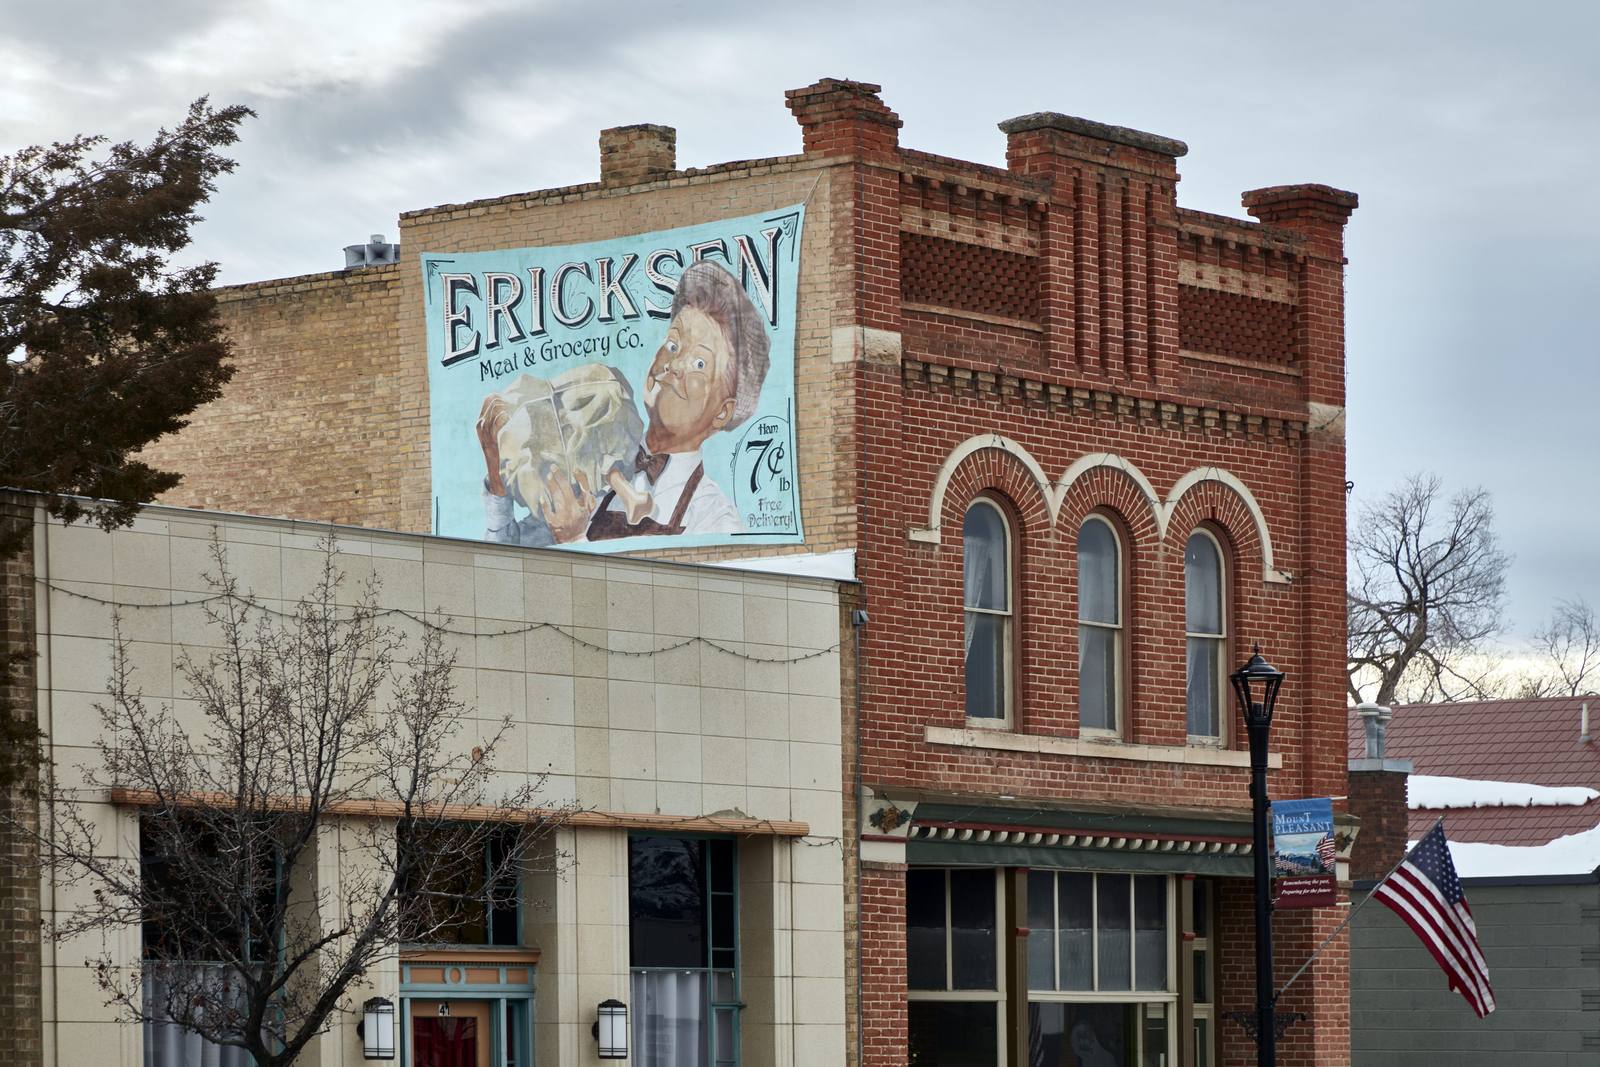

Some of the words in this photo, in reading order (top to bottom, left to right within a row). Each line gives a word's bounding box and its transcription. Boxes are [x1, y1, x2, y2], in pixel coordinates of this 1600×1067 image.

[440, 226, 784, 367] ERICKSN
[480, 353, 519, 381] Meat
[524, 346, 536, 367] &
[540, 339, 611, 361] Grocery
[616, 326, 644, 349] Co.
[758, 423, 779, 435] Ham
[779, 477, 791, 491] lb
[758, 498, 782, 511] Free
[747, 511, 793, 529] Delivery!
[1275, 821, 1331, 834] PLEASANT
